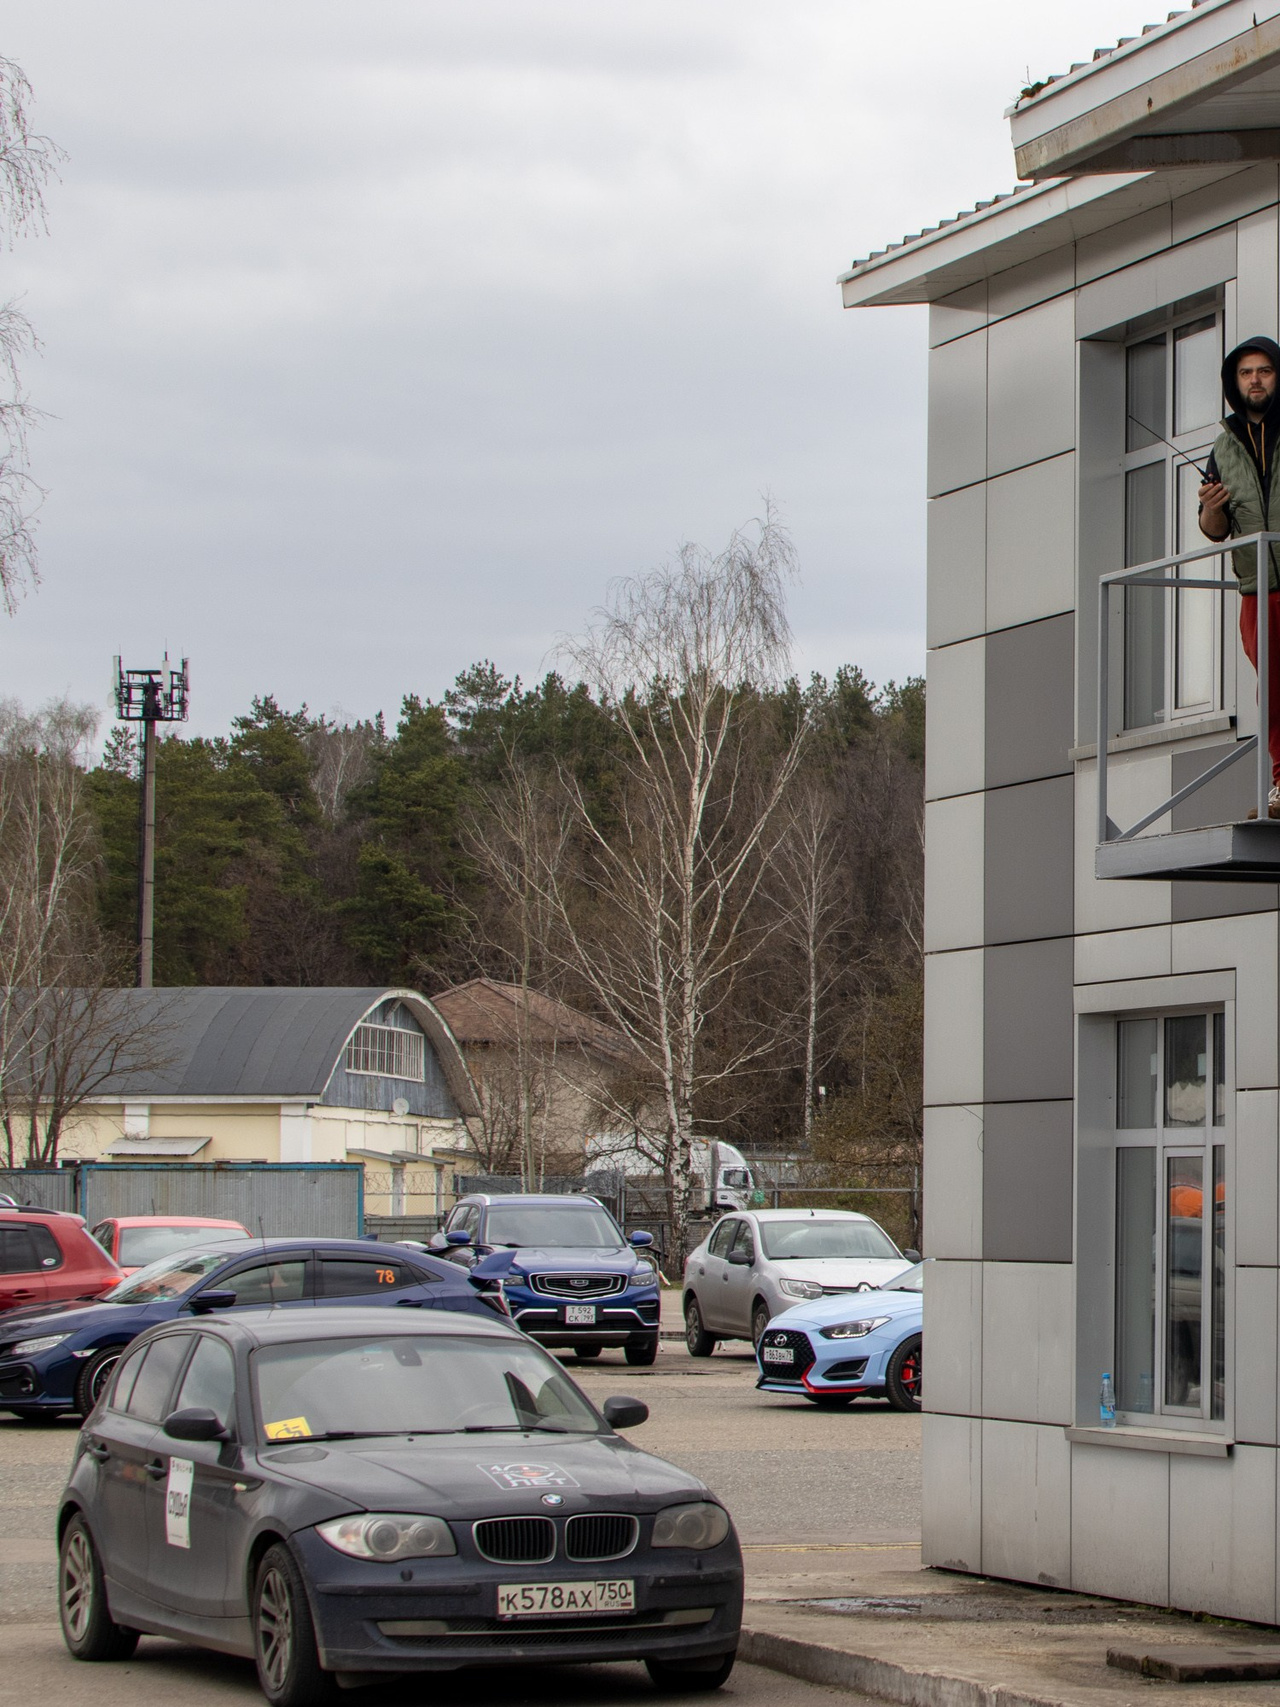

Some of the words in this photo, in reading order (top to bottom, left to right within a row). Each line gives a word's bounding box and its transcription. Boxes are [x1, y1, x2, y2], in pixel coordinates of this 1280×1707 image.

[375, 1269, 395, 1284] 78
[577, 1306, 592, 1314] 592
[506, 1586, 593, 1611] К578АХ
[596, 1581, 628, 1601] 750
[604, 1600, 620, 1608] RUS
